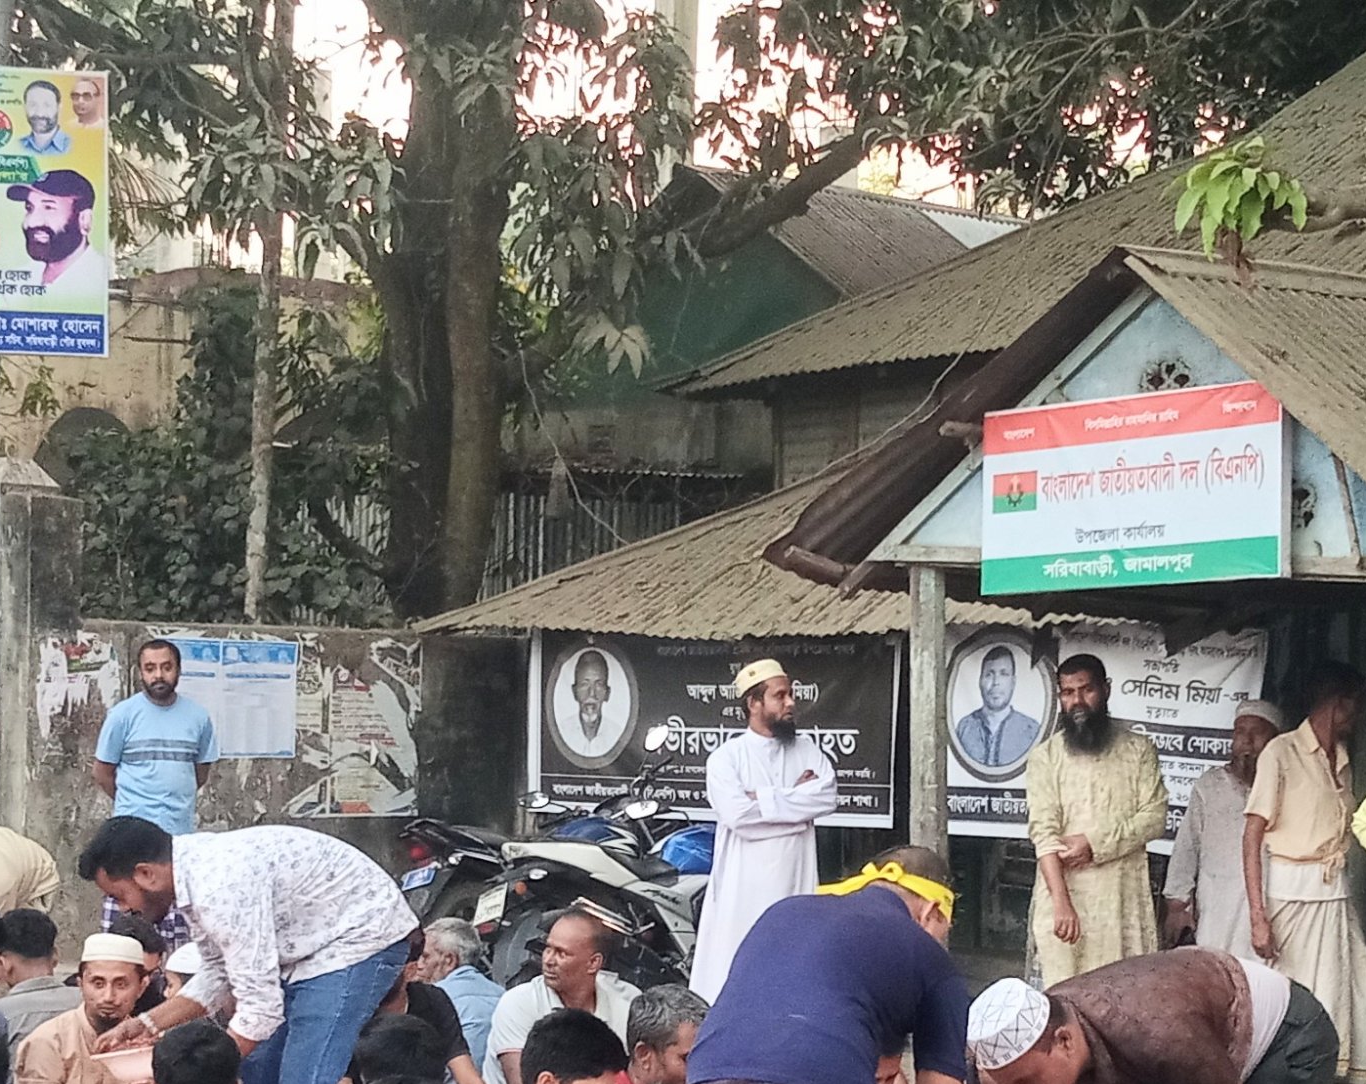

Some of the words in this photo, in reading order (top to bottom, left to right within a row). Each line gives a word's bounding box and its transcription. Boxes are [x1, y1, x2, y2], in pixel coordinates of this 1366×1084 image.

[5, 269, 32, 281] হোক
[20, 284, 47, 296] হোক
[62, 319, 102, 335] হোসেন
[1041, 469, 1094, 504] বাংলাদেশ
[1098, 451, 1176, 500] জাতীয়তাবাদী
[1179, 459, 1201, 485] দল
[1204, 443, 1265, 494] (বিএনপি)
[1075, 524, 1120, 545] উপজেলা
[1122, 521, 1166, 542] কার্যালয়
[1042, 554, 1118, 580] সরিষাবাড়ী,
[1122, 551, 1193, 575] জামালপুর
[1121, 674, 1181, 701] সেলিম
[1186, 679, 1223, 705] মিয়া
[947, 795, 989, 814] বাংলাদেশ
